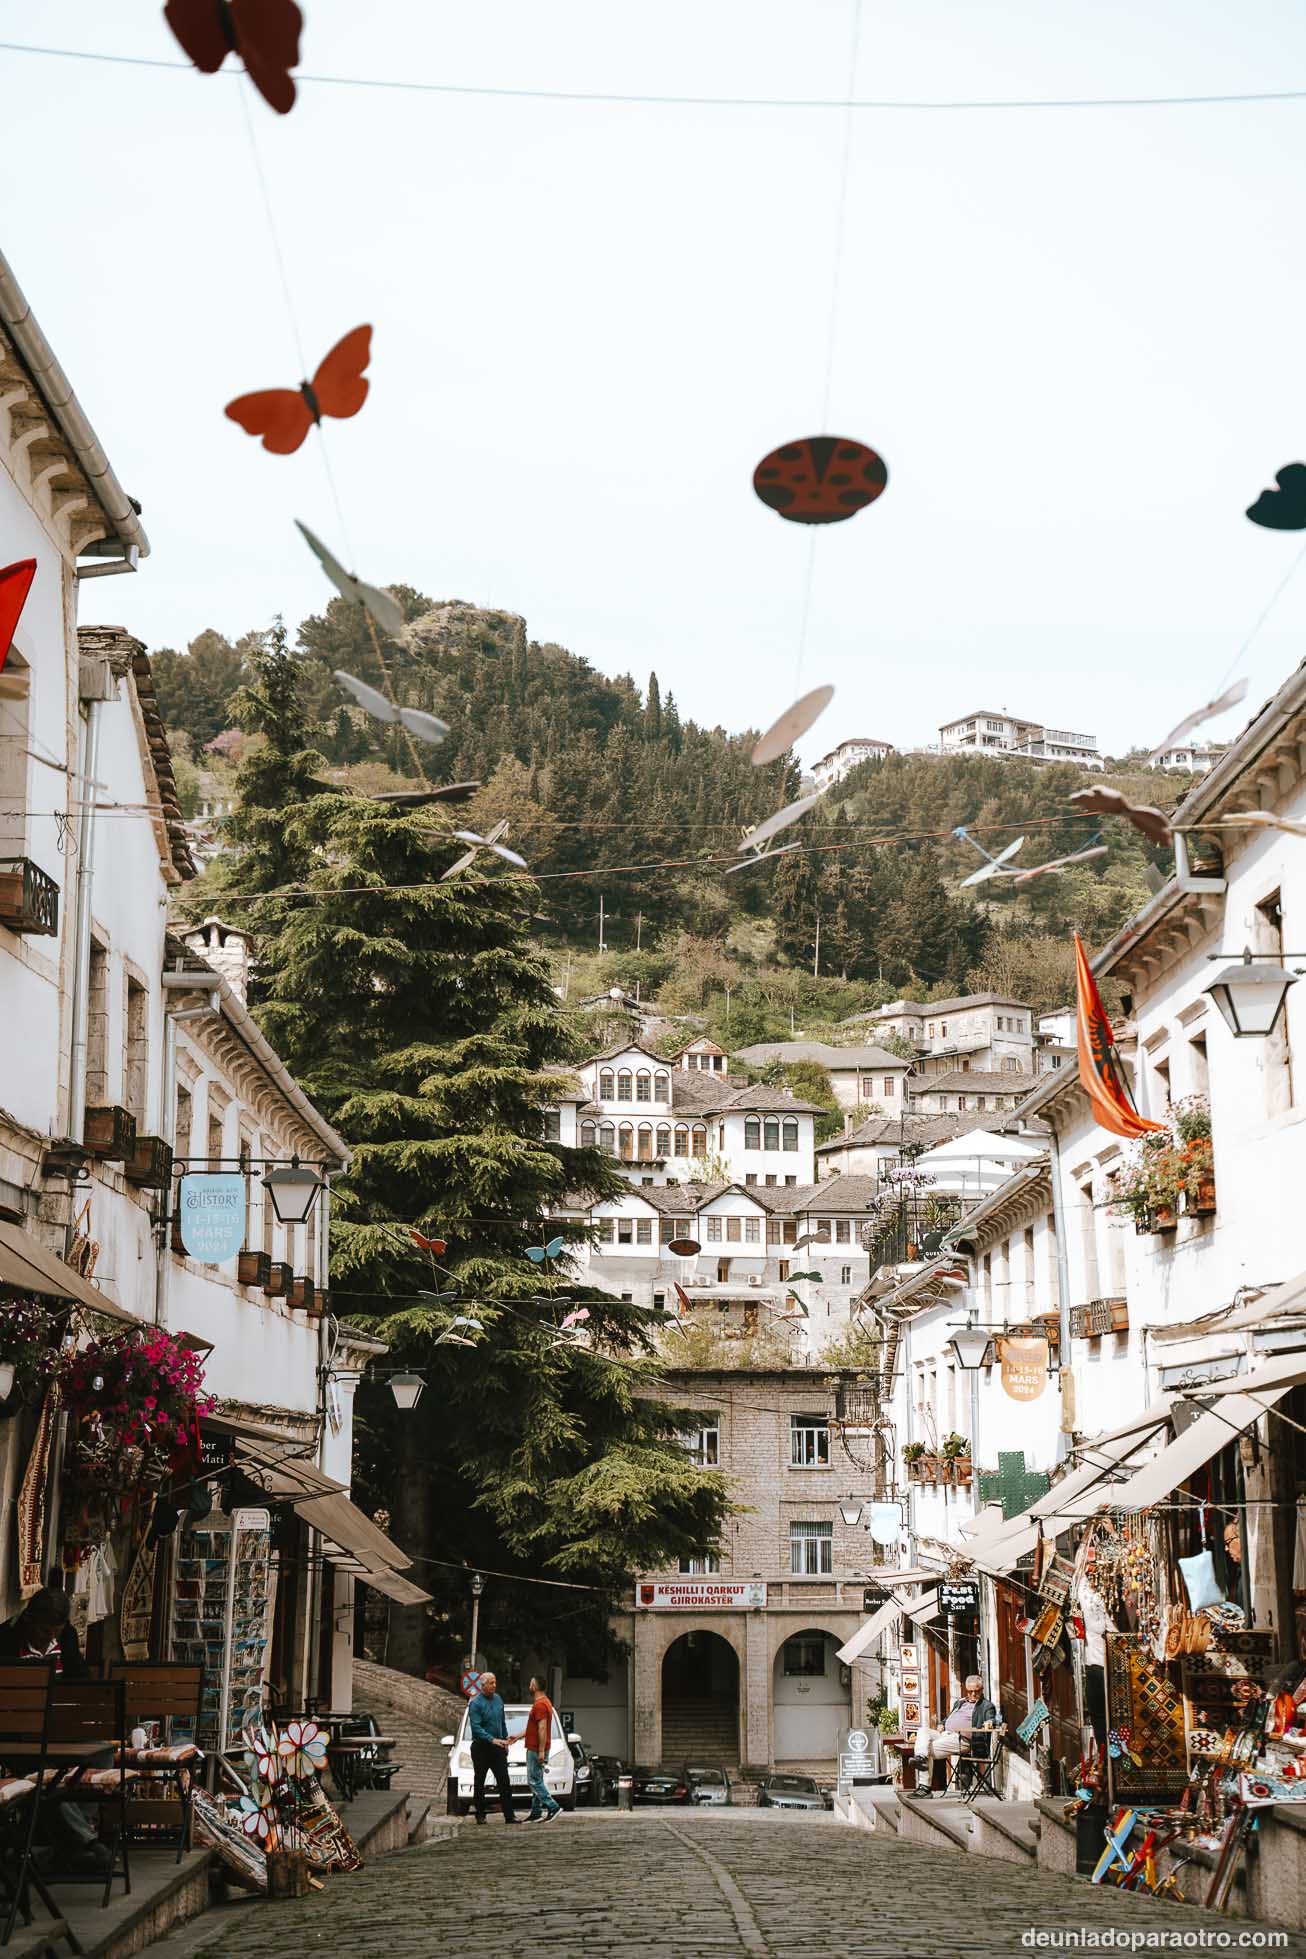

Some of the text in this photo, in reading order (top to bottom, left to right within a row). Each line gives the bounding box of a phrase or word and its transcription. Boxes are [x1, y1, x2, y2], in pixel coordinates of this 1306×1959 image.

[192, 1227, 233, 1239] MARS
[1008, 1375, 1040, 1385] MARS
[200, 1440, 217, 1450] ber
[658, 1585, 745, 1595] KËSHILLI I QARKUT
[942, 1585, 973, 1595] Fast
[670, 1595, 734, 1605] GJIROKASTËR
[941, 1595, 975, 1604] Food
[563, 1714, 571, 1727] P
